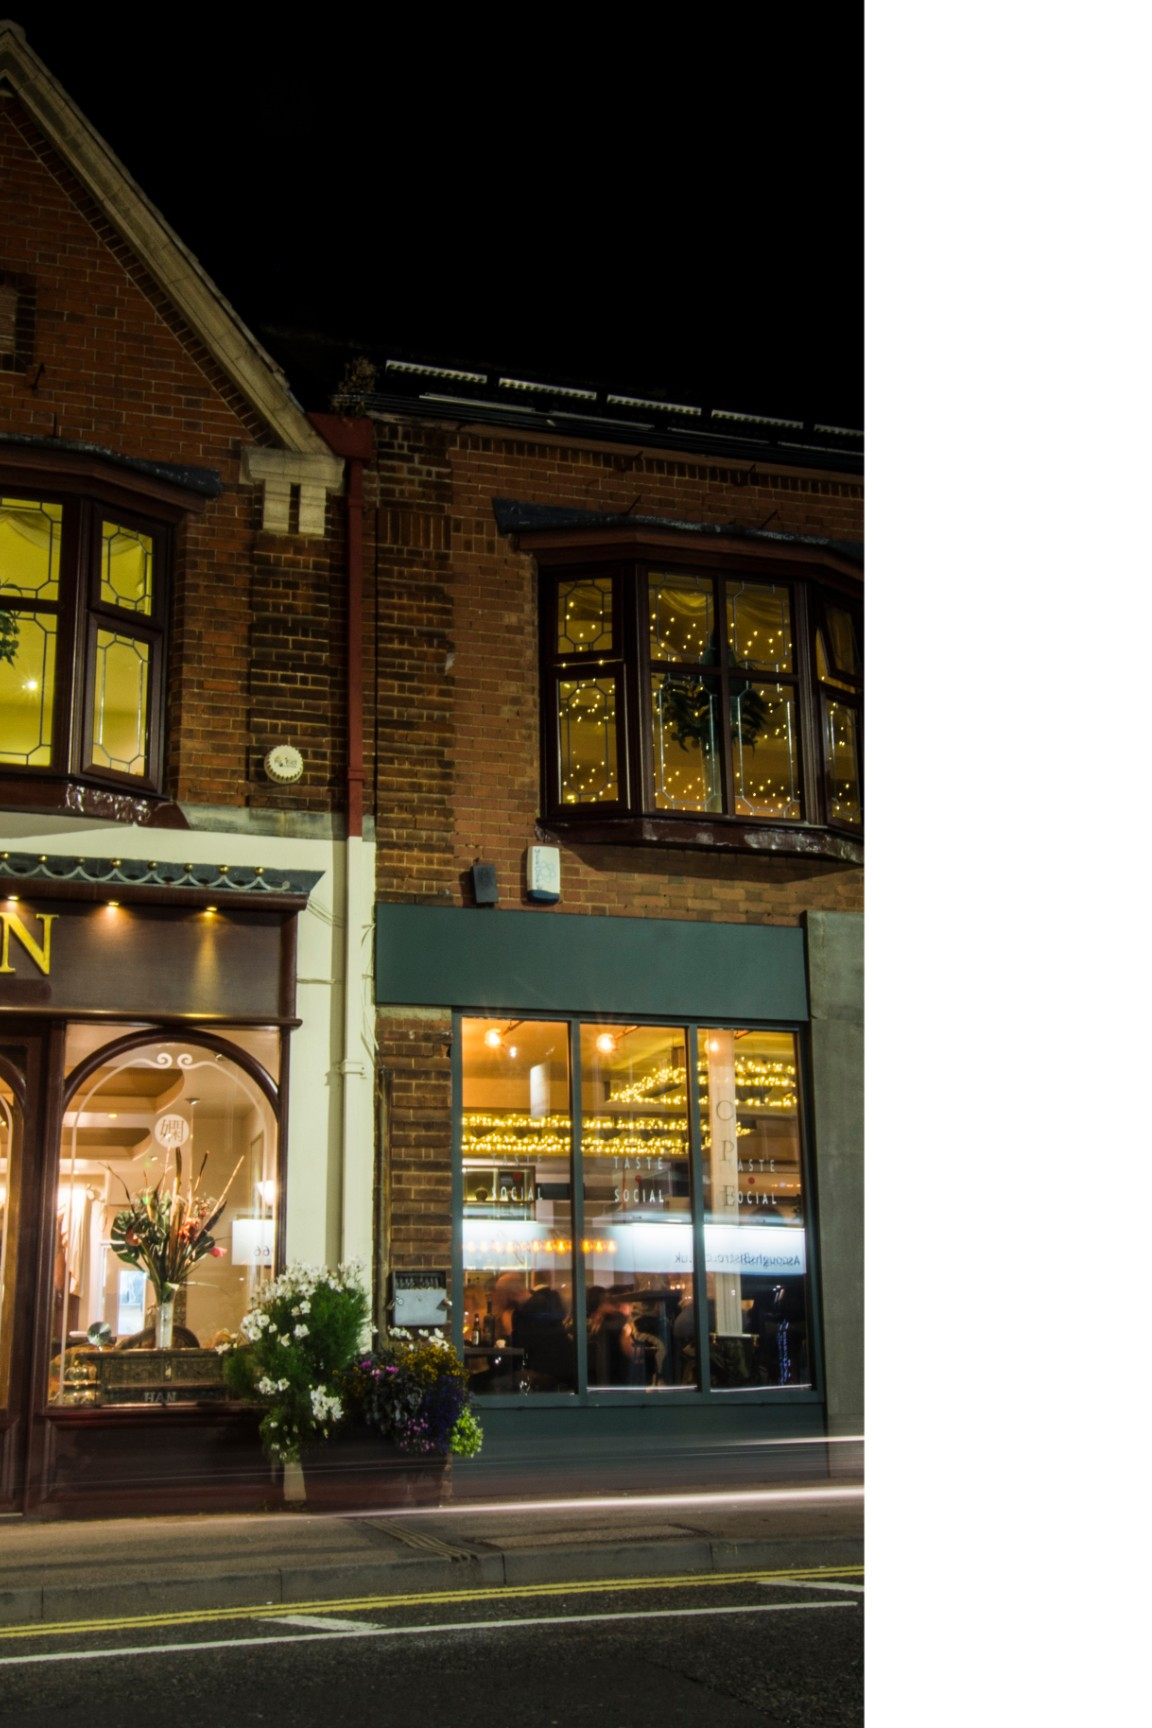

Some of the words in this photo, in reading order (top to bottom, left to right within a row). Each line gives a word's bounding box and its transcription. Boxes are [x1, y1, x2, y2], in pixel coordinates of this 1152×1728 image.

[491, 1153, 543, 1167] TASTE
[614, 1156, 664, 1170] TASTE
[491, 1186, 543, 1201] SOCIAL
[614, 1188, 665, 1203] SOCIAL
[143, 1390, 178, 1403] HAN
